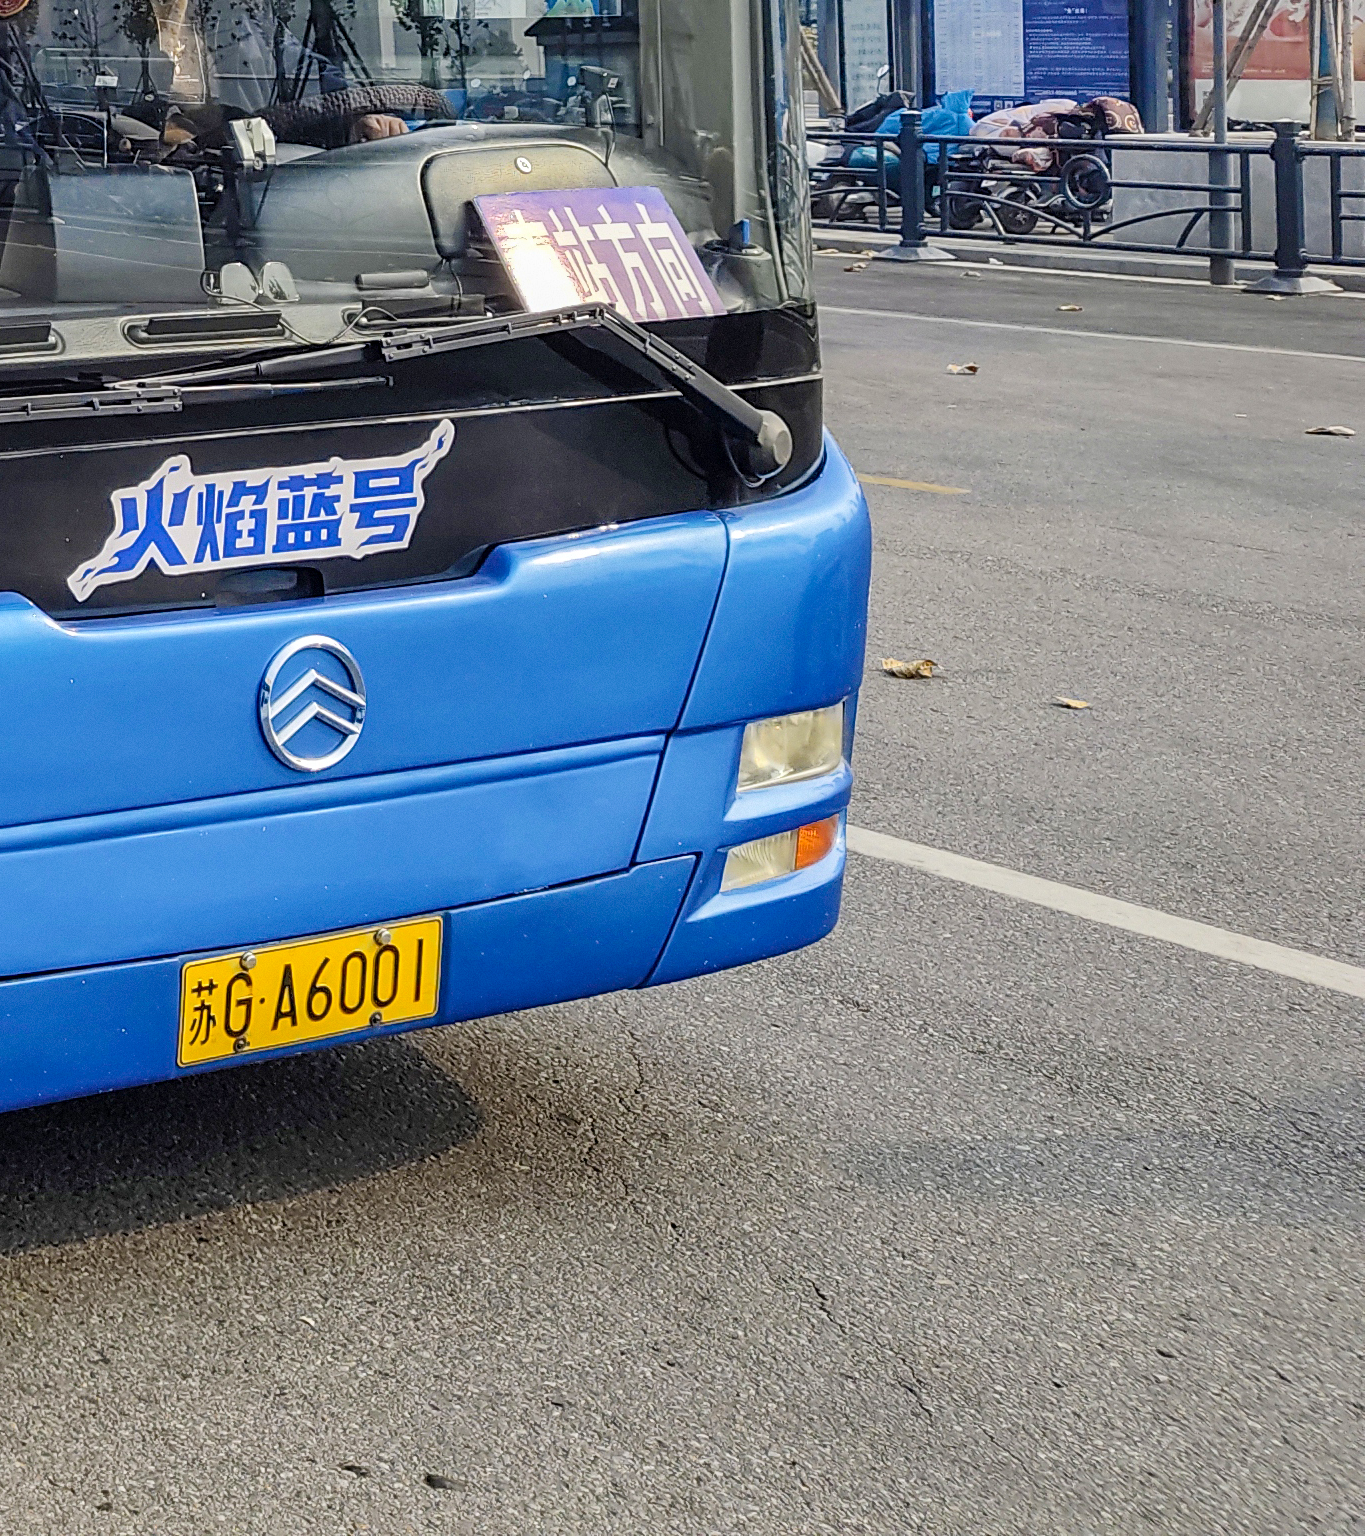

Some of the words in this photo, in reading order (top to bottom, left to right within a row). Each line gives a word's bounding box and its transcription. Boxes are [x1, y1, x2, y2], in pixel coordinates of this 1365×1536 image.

[498, 202, 713, 319] 站方向
[99, 456, 434, 580] 火焰蓝号
